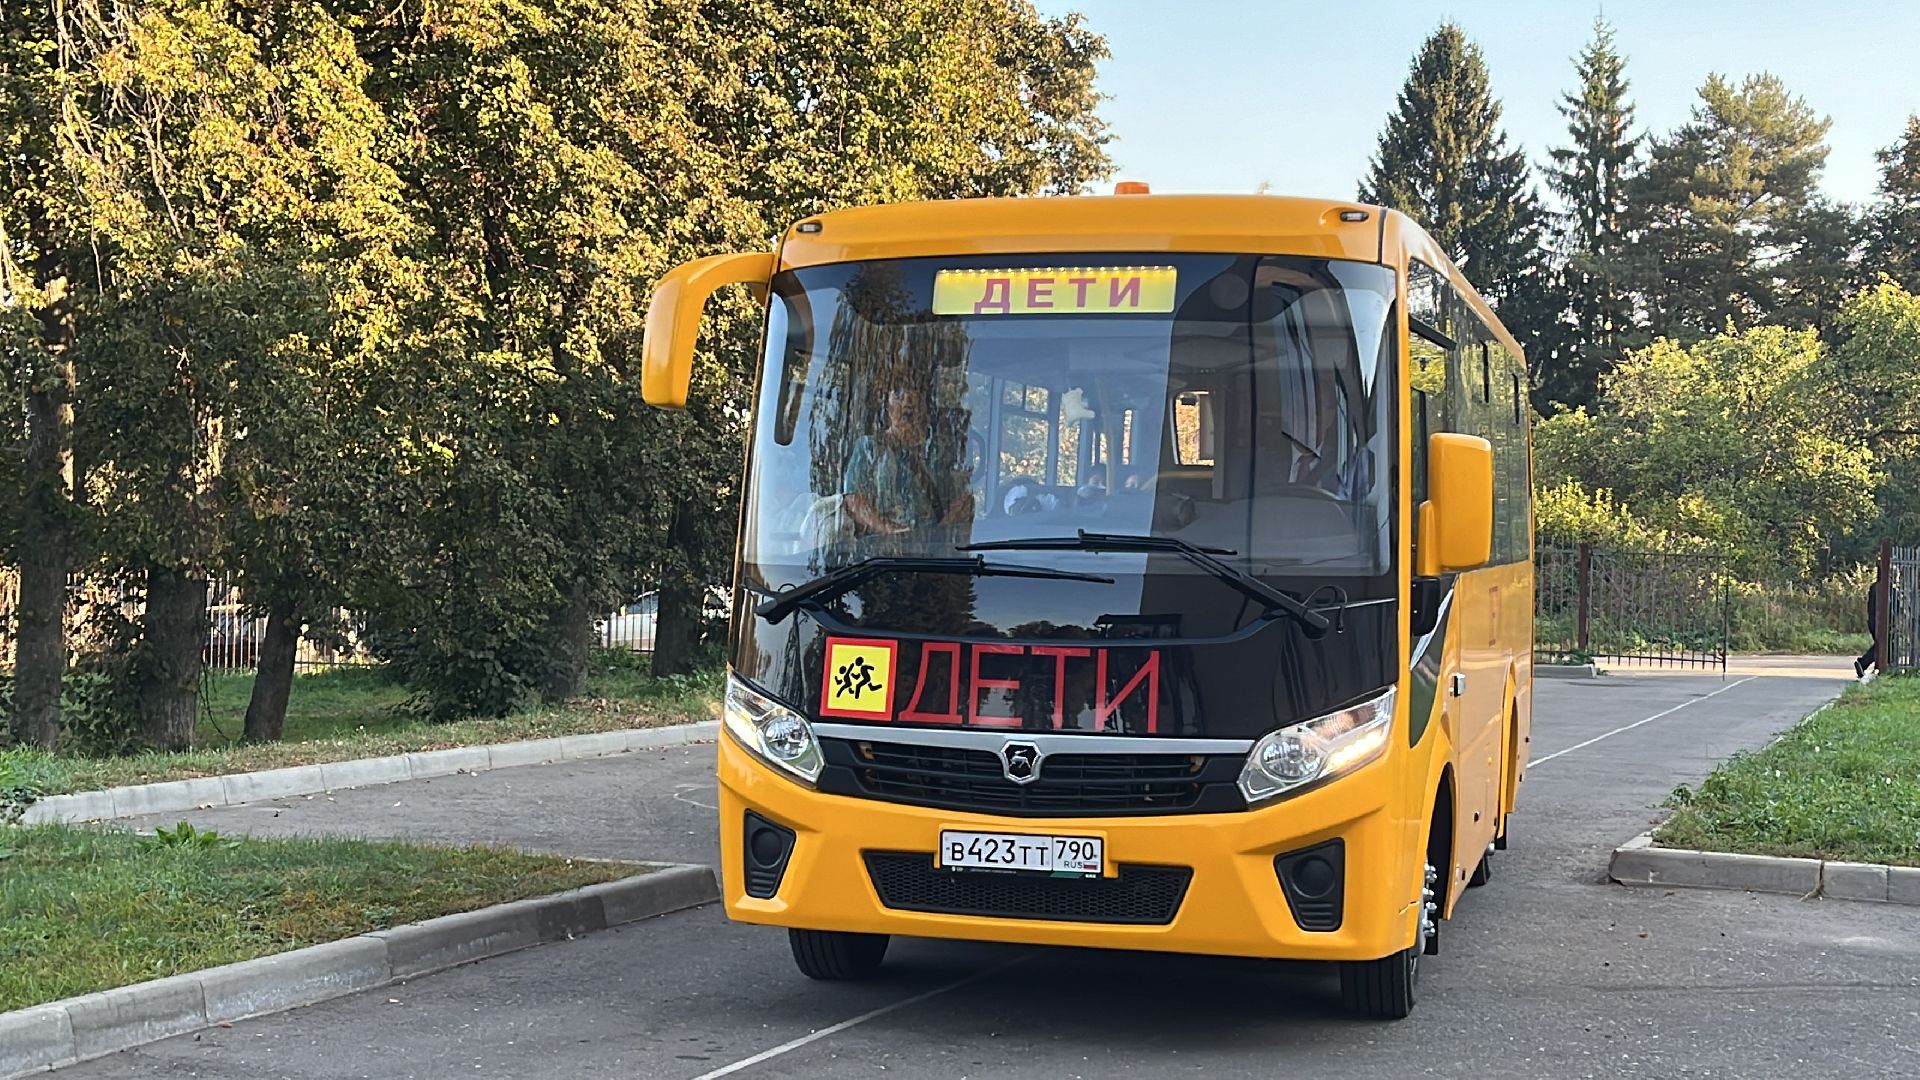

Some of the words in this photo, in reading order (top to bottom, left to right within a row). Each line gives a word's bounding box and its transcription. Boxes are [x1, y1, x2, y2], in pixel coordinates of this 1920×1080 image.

[974, 277, 1141, 314] ДЕТИ
[897, 641, 1160, 734] ДЕТИ
[1055, 840, 1094, 860] 790
[1063, 860, 1083, 869] RUS
